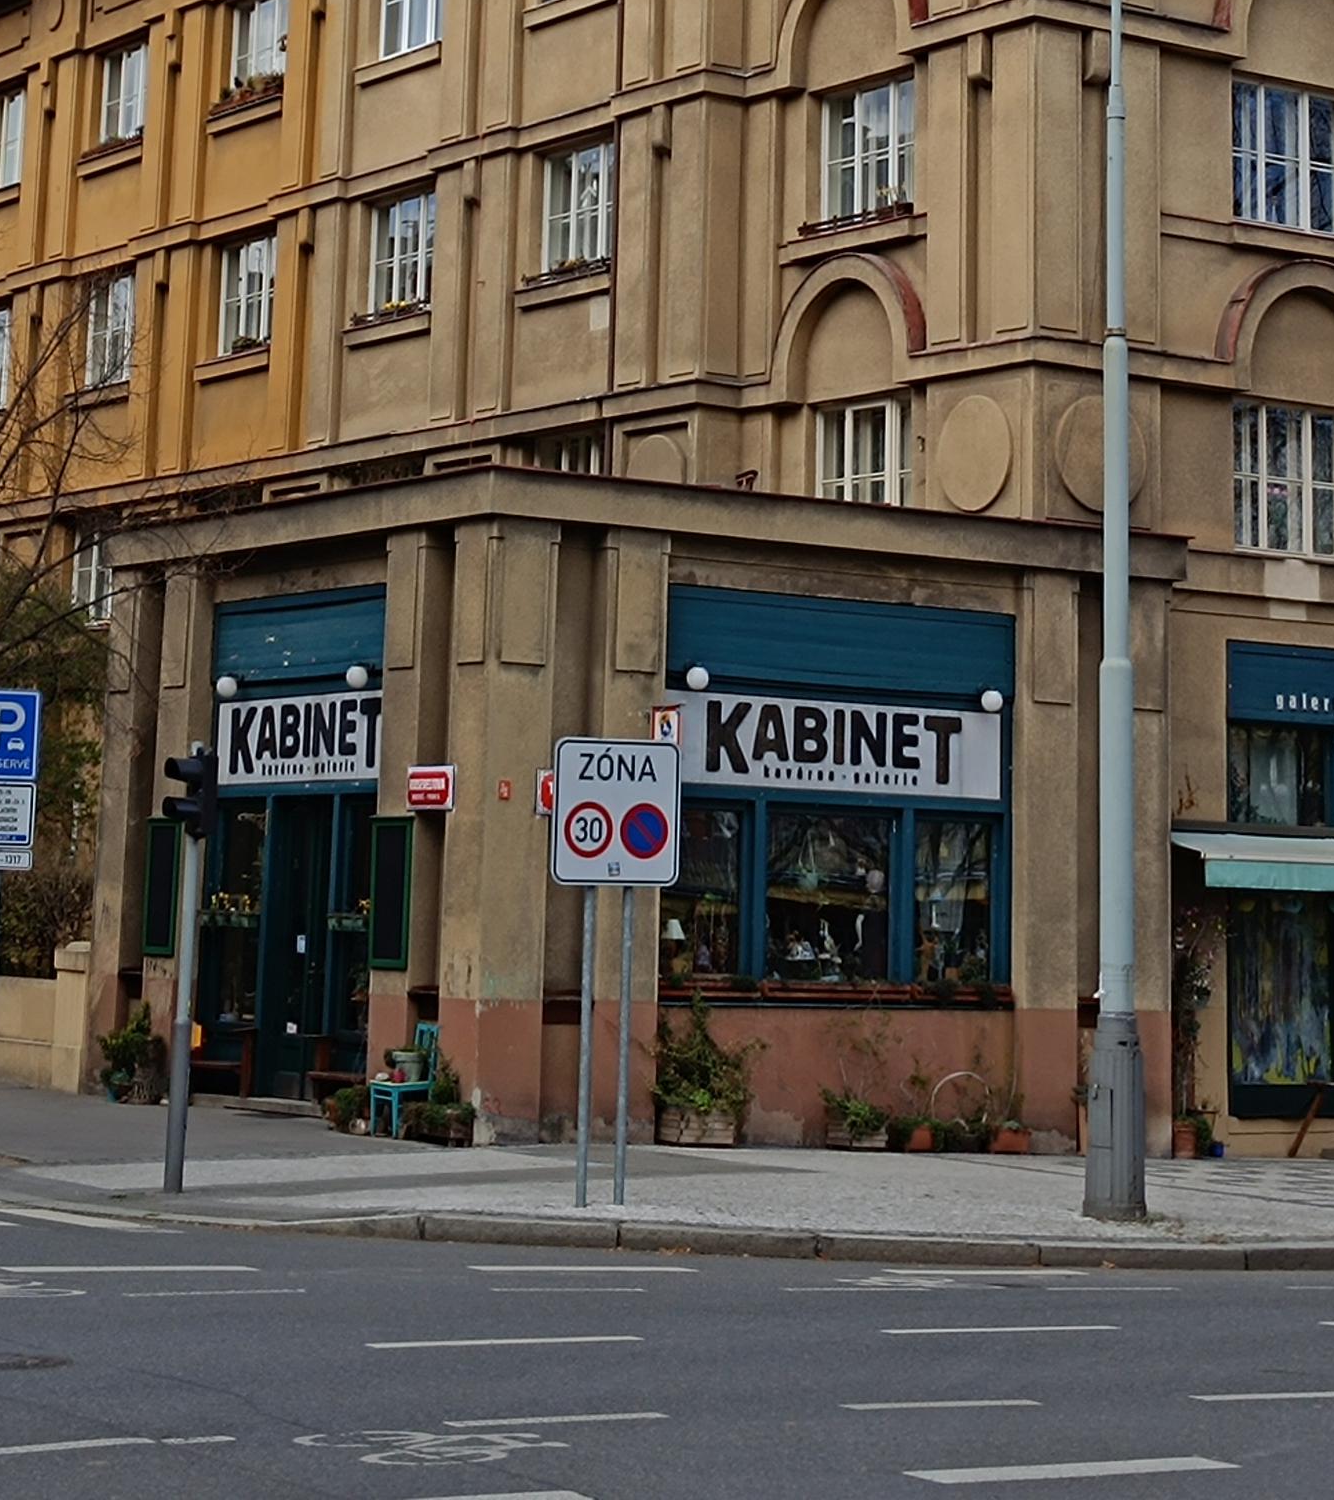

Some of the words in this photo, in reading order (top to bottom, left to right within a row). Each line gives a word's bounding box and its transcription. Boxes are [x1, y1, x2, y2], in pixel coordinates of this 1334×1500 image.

[229, 697, 382, 775] KABINET
[705, 700, 962, 785] KABINET
[578, 747, 657, 782] ZÓNA
[575, 816, 603, 843] 30
